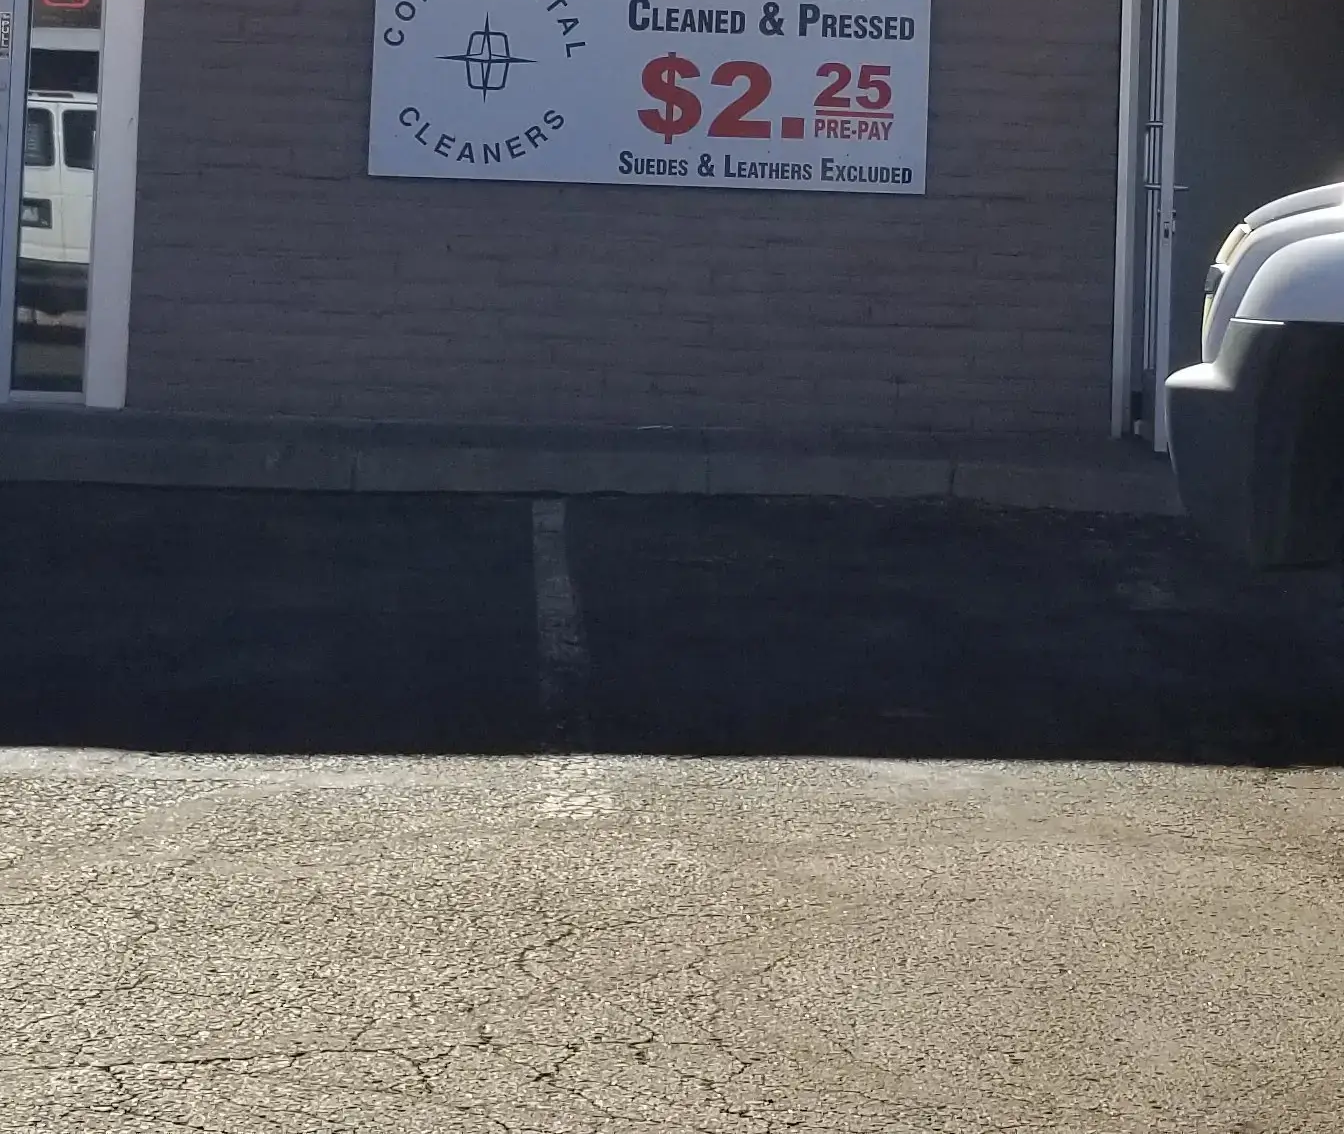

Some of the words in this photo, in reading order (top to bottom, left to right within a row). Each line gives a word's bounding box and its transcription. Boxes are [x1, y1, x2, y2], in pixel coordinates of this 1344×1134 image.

[758, 1, 785, 37] &
[399, 106, 565, 164] CLEANERS
[814, 118, 894, 141] PRE-PAY
[697, 153, 715, 178] &
